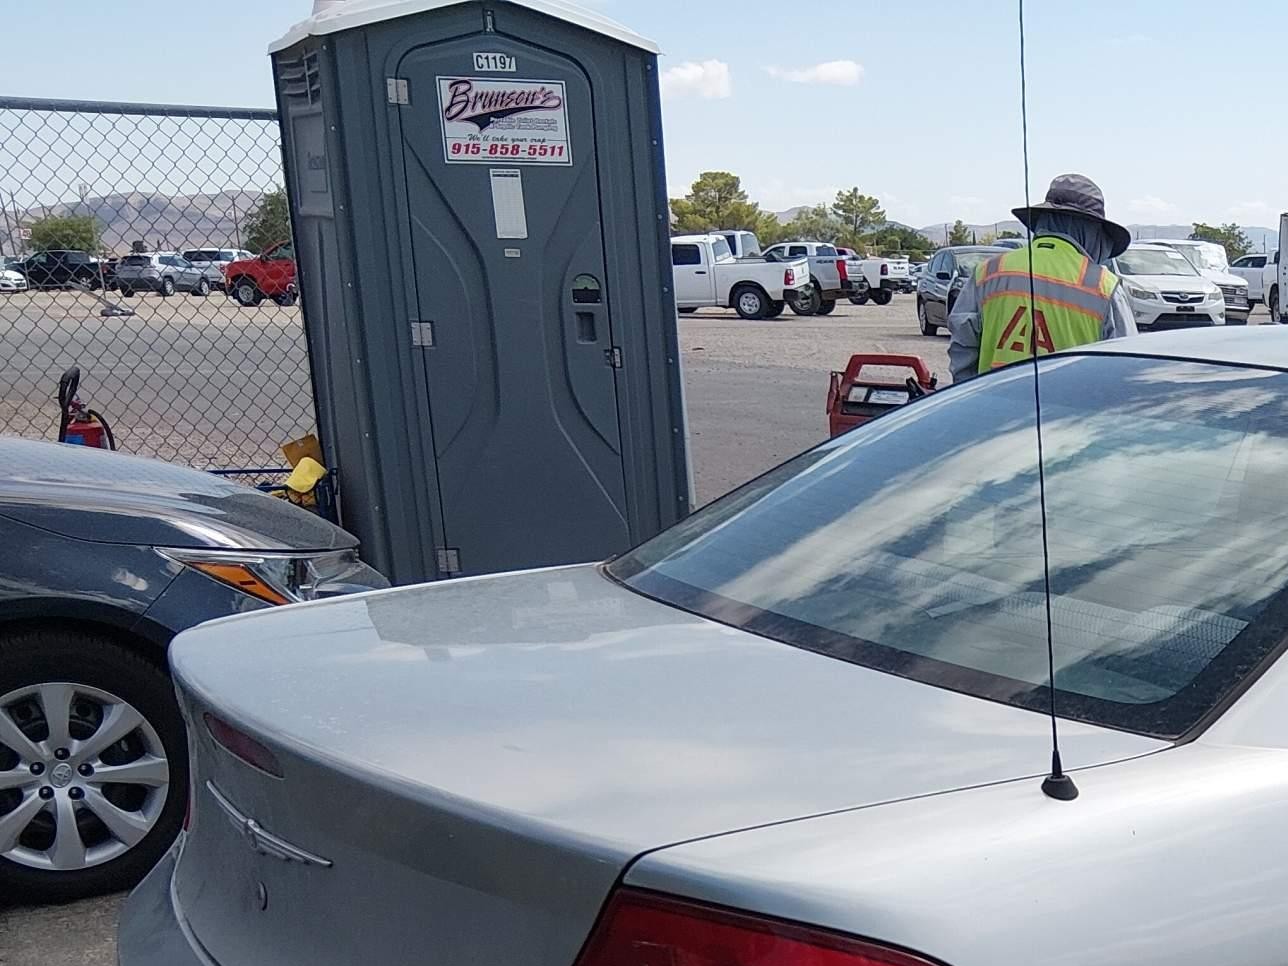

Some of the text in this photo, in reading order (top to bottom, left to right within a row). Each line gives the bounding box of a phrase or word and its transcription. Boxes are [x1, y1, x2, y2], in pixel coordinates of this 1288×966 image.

[475, 54, 514, 69] C1197
[445, 80, 562, 120] Brunson's
[451, 143, 564, 157] 915-858-5511
